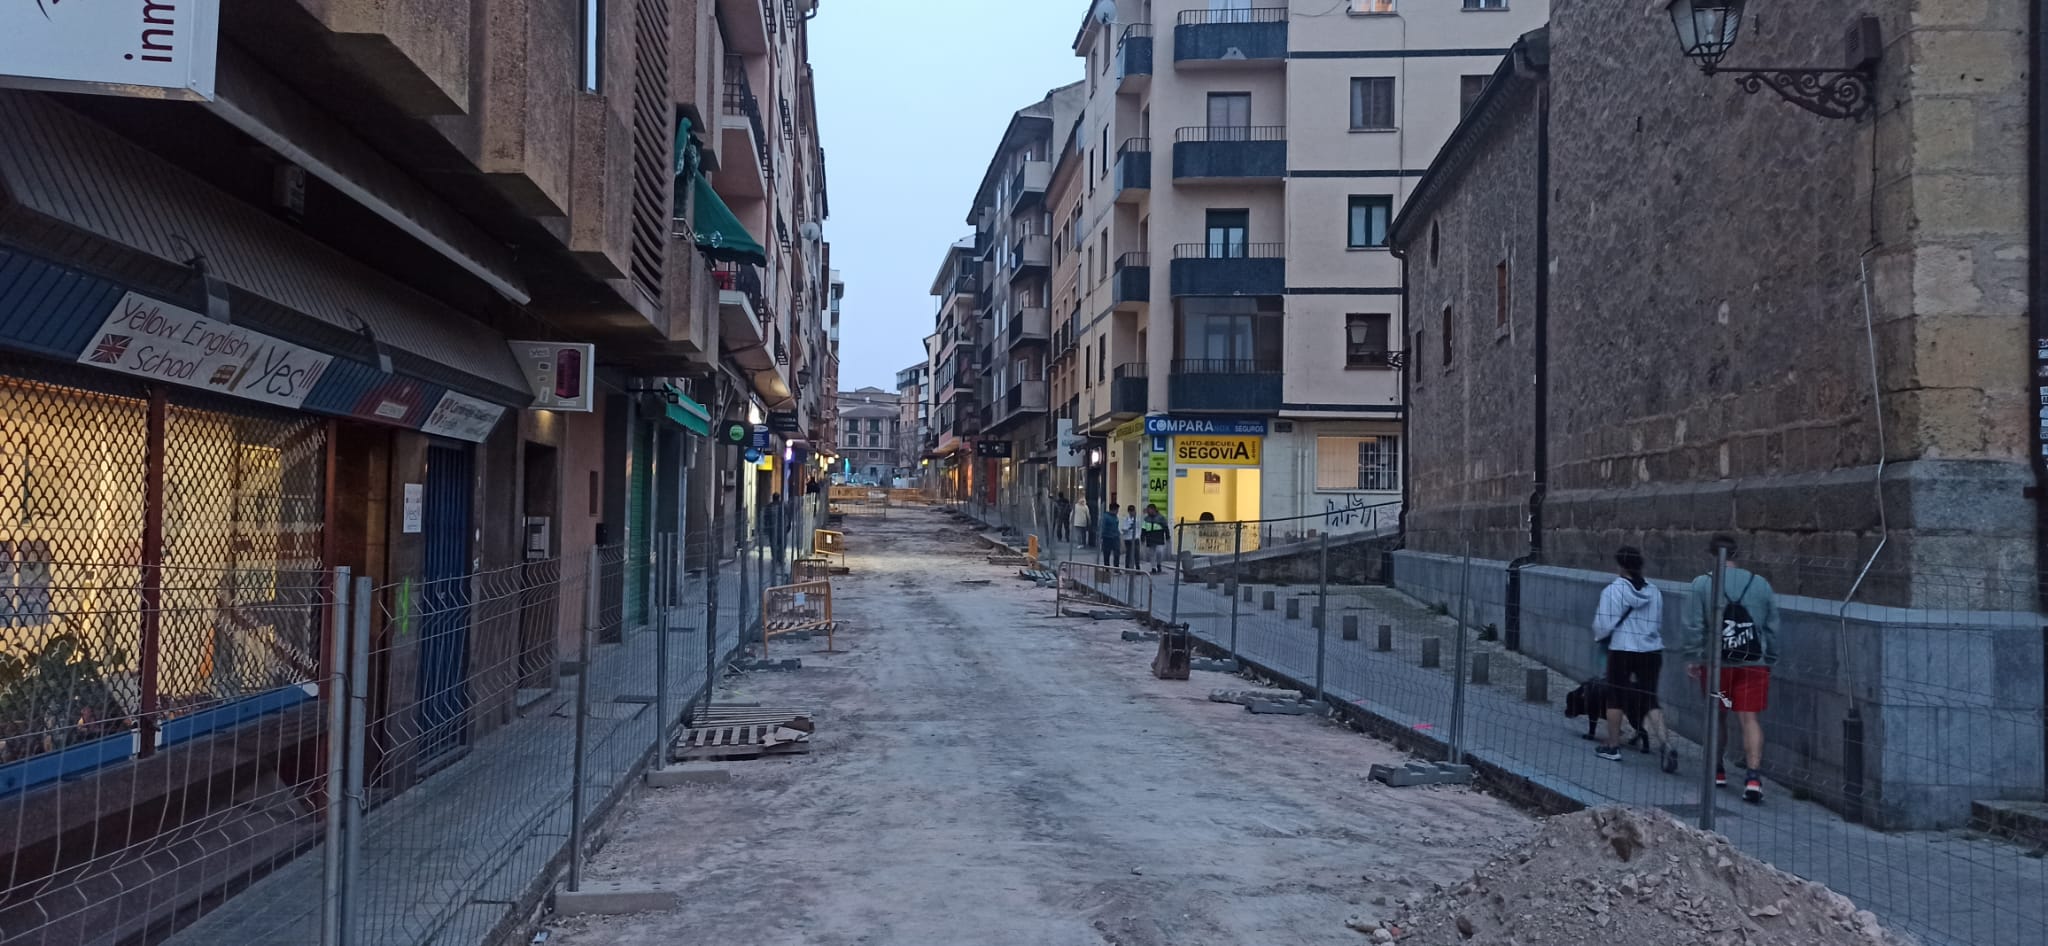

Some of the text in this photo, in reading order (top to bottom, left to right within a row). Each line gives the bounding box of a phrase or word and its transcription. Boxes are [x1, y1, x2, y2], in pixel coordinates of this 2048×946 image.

[112, 297, 249, 359] Yellow English
[129, 345, 204, 380] School
[1234, 425, 1264, 433] SEGUROS
[1153, 437, 1165, 451] L
[1178, 441, 1250, 459] SEGOVIA
[1149, 477, 1168, 492] CAP
